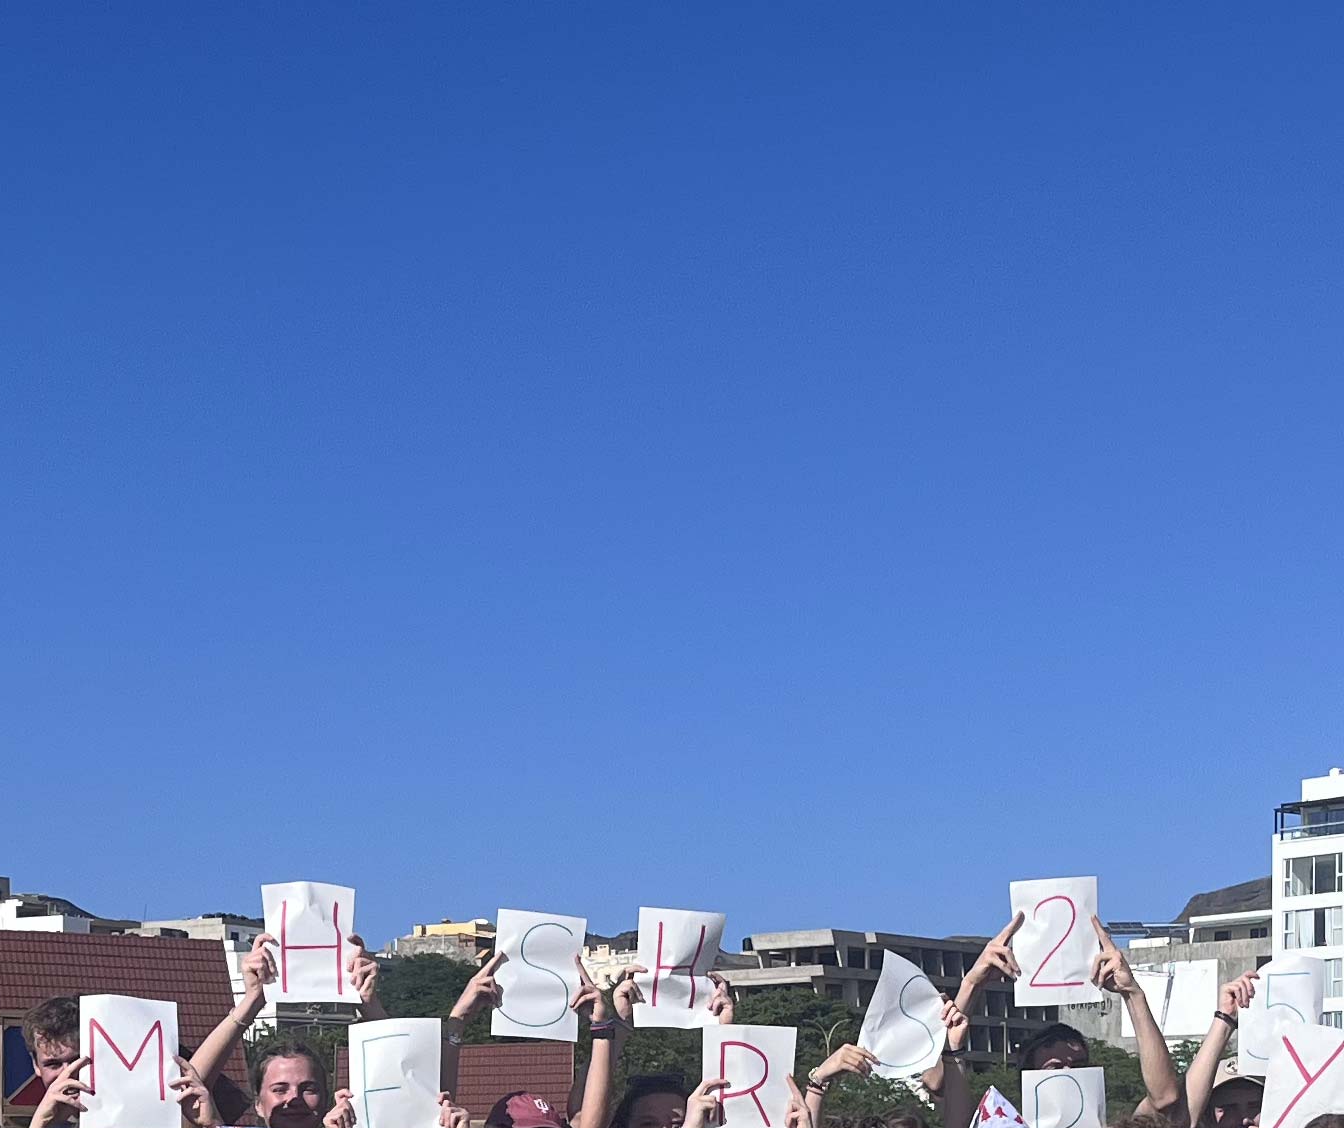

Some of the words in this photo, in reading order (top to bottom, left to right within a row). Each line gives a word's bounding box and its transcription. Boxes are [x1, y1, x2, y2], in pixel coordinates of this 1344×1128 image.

[281, 901, 343, 995] H
[499, 922, 573, 1027] S
[652, 921, 706, 1009] H
[878, 974, 935, 1069] S
[1029, 895, 1084, 988] 2
[89, 1018, 166, 1101] M
[718, 1040, 771, 1128] R
